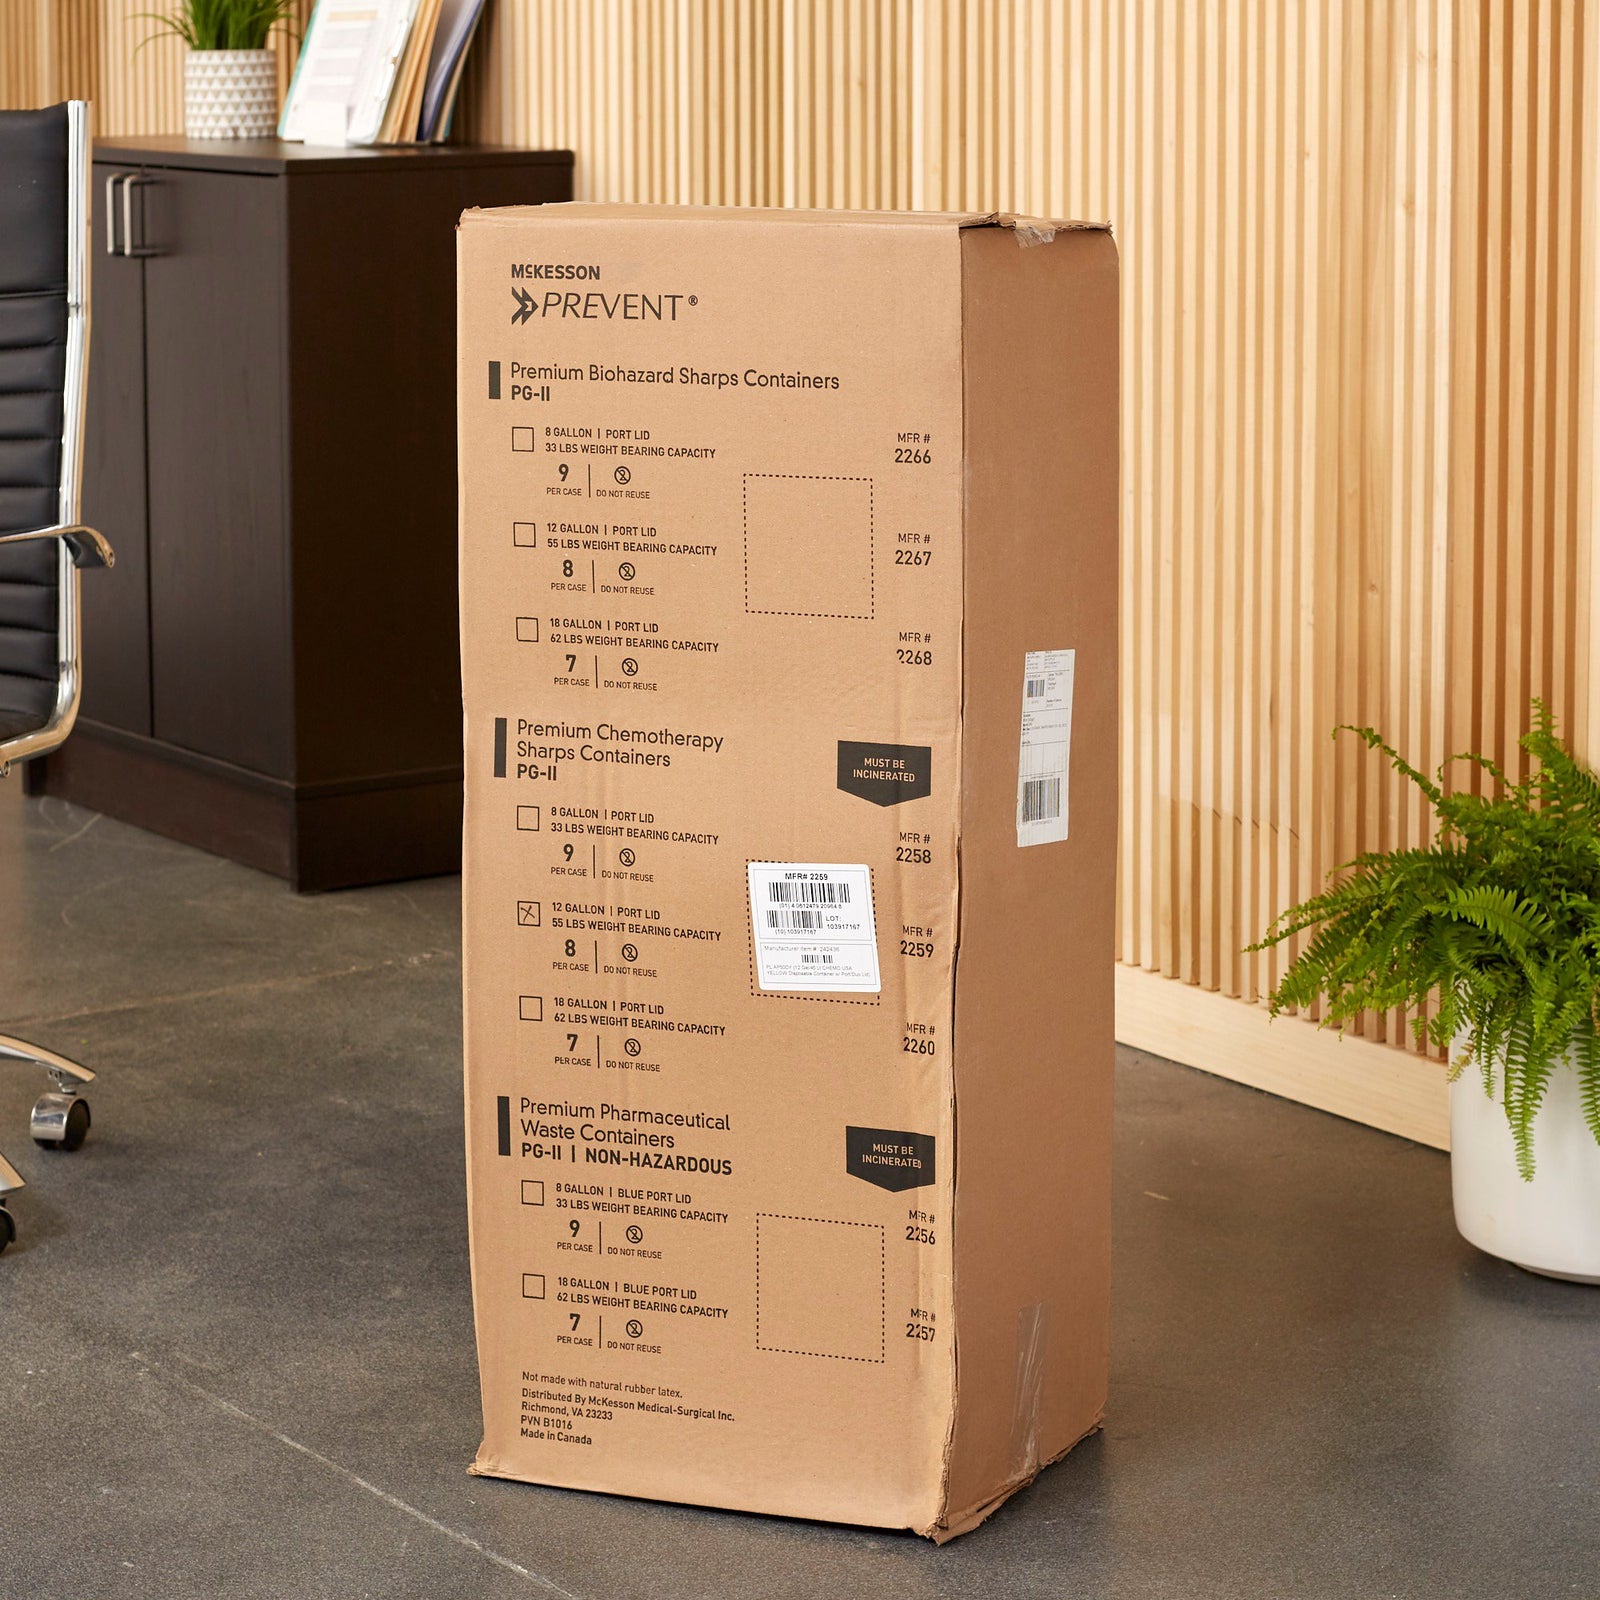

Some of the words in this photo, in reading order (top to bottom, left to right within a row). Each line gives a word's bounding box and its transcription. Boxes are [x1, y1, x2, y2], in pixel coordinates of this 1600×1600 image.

[542, 292, 684, 320] PREVENT
[512, 362, 583, 380] Premium
[590, 364, 674, 383] Biohazard
[680, 367, 738, 390] Sharps
[744, 369, 839, 389] Containers
[512, 385, 550, 401] PG-II
[546, 427, 551, 436] 8
[554, 427, 592, 438] GALLON
[606, 429, 632, 439] PORT
[634, 430, 650, 440] LID
[898, 432, 920, 443] MFR
[924, 434, 930, 444] #
[546, 442, 556, 452] 33
[560, 443, 578, 453] LBS
[580, 444, 618, 454] WEIGHT
[621, 446, 664, 456] BEARING
[668, 448, 716, 458] CAPACITY
[895, 448, 931, 464] 2266
[558, 464, 569, 482] 9
[546, 487, 561, 495] PER
[563, 488, 582, 496] CASE
[596, 489, 606, 497] DO
[608, 490, 624, 498] NOT
[626, 490, 650, 499] REUSE
[547, 523, 557, 532] 12
[560, 523, 598, 534] GALLON
[613, 526, 638, 536] PORT
[641, 527, 656, 537] LID
[898, 533, 920, 543] MFR
[924, 534, 930, 544] #
[548, 538, 558, 548] 55
[561, 539, 580, 549] LBS
[582, 540, 620, 551] WEIGHT
[623, 542, 666, 553] BEARING
[669, 544, 717, 556] CAPACITY
[895, 550, 932, 566] 2267
[563, 560, 573, 578] 8
[551, 582, 566, 590] PER
[567, 583, 586, 592] CASE
[550, 618, 560, 627] 18
[563, 618, 602, 630] GALLON
[615, 621, 640, 632] PORT
[643, 623, 658, 633] LID
[566, 654, 576, 672] 7
[518, 718, 591, 739] Premium
[597, 724, 724, 753] Chemotherapy
[517, 740, 575, 763] Sharps
[580, 745, 670, 767] Containers
[517, 764, 556, 781] PG-II
[864, 758, 890, 768] MUST
[893, 760, 905, 769] BE
[854, 769, 915, 782] INCINERATED
[551, 806, 557, 816] 8
[560, 807, 598, 819] GALLON
[611, 810, 636, 822] PORT
[639, 813, 654, 823] LID
[900, 832, 920, 843] MFR
[924, 834, 930, 844] #
[563, 844, 574, 862] 9
[896, 846, 931, 864] 2258
[551, 866, 566, 875] PER
[568, 868, 587, 876] CASE
[552, 902, 562, 912] 12
[565, 903, 604, 915] GALLON
[618, 907, 642, 918] PORT
[645, 910, 660, 920] LID
[552, 918, 563, 928] 55
[566, 919, 585, 929] LBS
[588, 920, 626, 932] WEIGHT
[628, 924, 671, 936] BEARING
[674, 928, 721, 941] CAPACITY
[902, 925, 923, 937] MFR
[926, 928, 932, 937] #
[565, 939, 576, 957] 8
[900, 940, 934, 958] 2259
[554, 997, 564, 1006] 18
[568, 998, 607, 1010] GALLON
[620, 1002, 646, 1013] PORT
[648, 1004, 664, 1014] LID
[567, 1034, 578, 1052] 7
[903, 1036, 935, 1055] 2260
[521, 1097, 594, 1118] Premium
[601, 1103, 730, 1130] Pharmaceutical
[520, 1118, 575, 1140] Waste
[580, 1124, 674, 1148] Containers
[522, 1142, 561, 1160] PG-II
[586, 1147, 732, 1175] NON-HAZARDOUS
[873, 1144, 898, 1154] MUST
[901, 1146, 913, 1155] BE
[862, 1154, 921, 1168] INCINERATED
[556, 1182, 562, 1192] 8
[564, 1183, 604, 1196] GALLON
[618, 1188, 644, 1200] BLUE
[647, 1191, 673, 1202] PORT
[676, 1194, 691, 1204] LID
[556, 1198, 568, 1208] 33
[570, 1200, 589, 1210] LBS
[592, 1201, 630, 1214] WEIGHT
[633, 1205, 677, 1218] BEARING
[680, 1210, 728, 1223] CAPACITY
[569, 1220, 580, 1238] 9
[558, 1277, 568, 1286] 18
[570, 1278, 609, 1291] GALLON
[624, 1283, 649, 1295] BLUE
[652, 1286, 678, 1298] PORT
[681, 1289, 696, 1300] LID
[570, 1313, 580, 1331] 7
[522, 1371, 538, 1382] Not
[541, 1375, 566, 1384] made
[568, 1377, 587, 1387] with
[590, 1381, 622, 1391] natural
[624, 1384, 656, 1395] rubber
[658, 1386, 682, 1398] latex.
[522, 1388, 572, 1402] Distributed
[575, 1394, 586, 1406] By
[588, 1396, 634, 1410] McKesson
[638, 1401, 716, 1419] Medical-Surgical
[718, 1410, 735, 1421] Inc.
[522, 1401, 569, 1416] Richmond,
[571, 1407, 584, 1417] VA
[586, 1408, 612, 1420] 23233
[521, 1414, 540, 1426] PVN
[544, 1417, 572, 1430] B1016
[520, 1427, 544, 1439] Made
[547, 1430, 555, 1440] in
[557, 1432, 592, 1445] Canada
